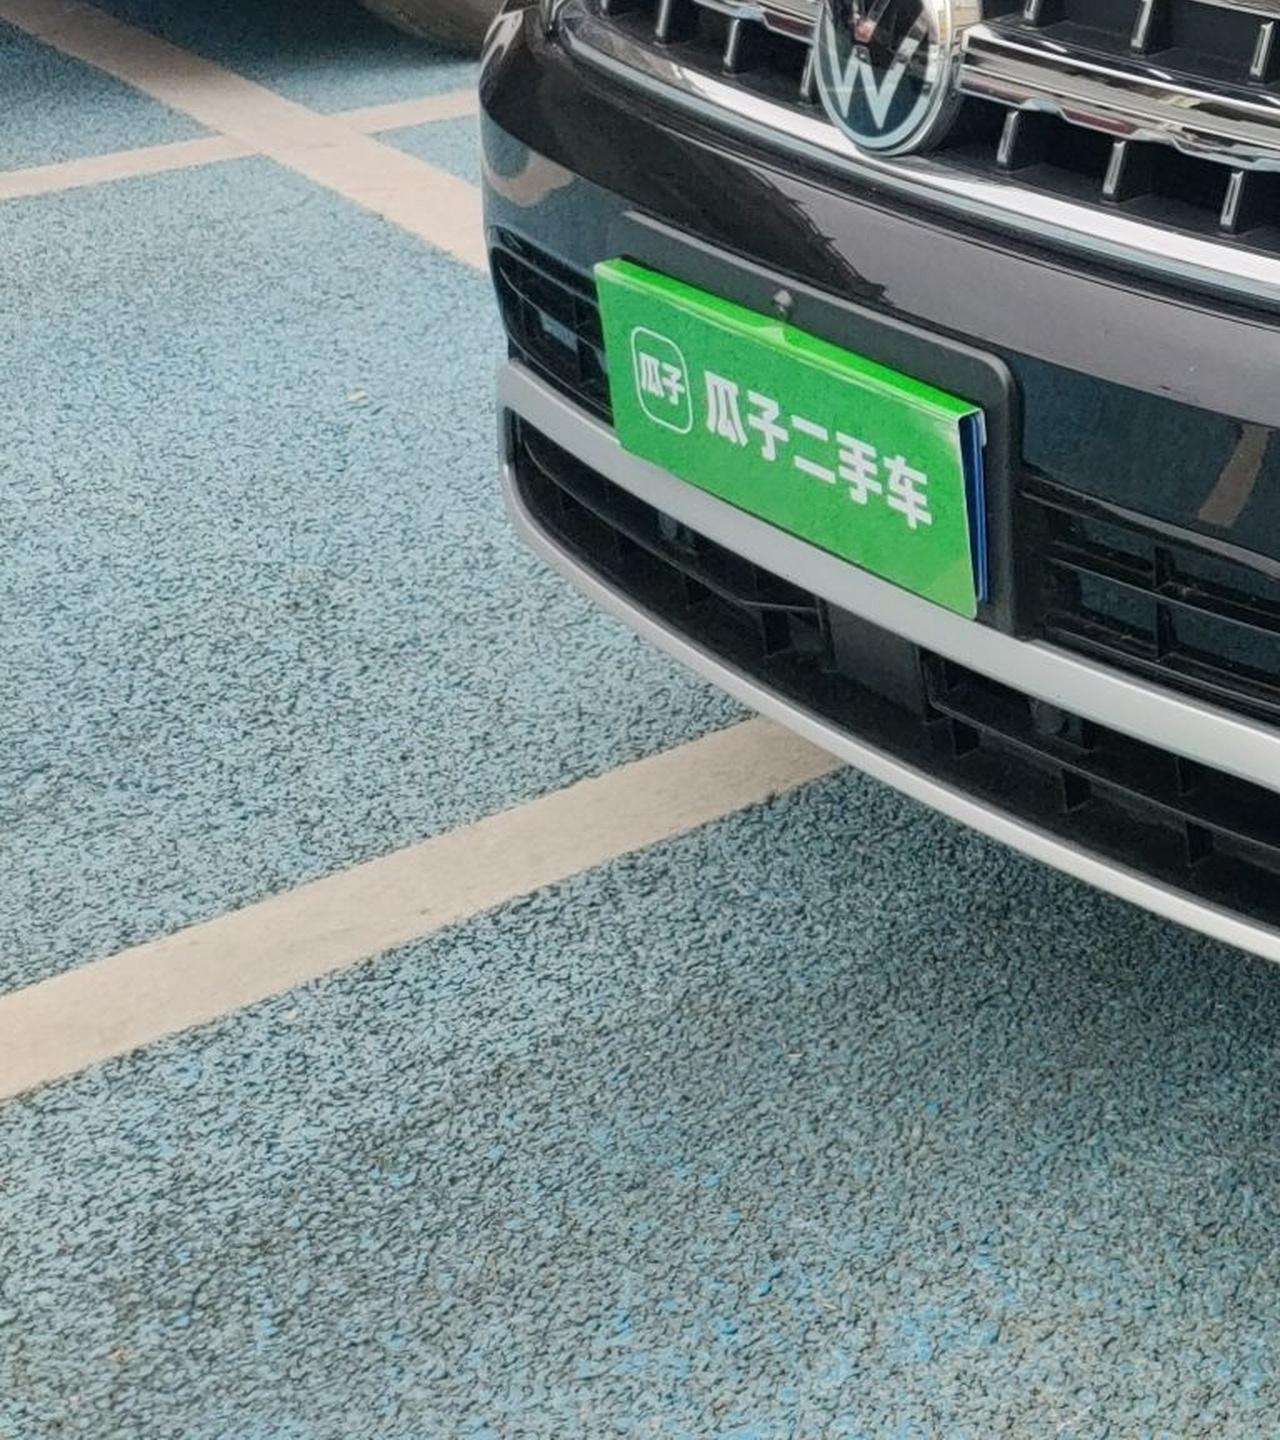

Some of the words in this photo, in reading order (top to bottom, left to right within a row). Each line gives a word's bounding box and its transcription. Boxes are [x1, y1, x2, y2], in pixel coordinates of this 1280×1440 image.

[638, 351, 686, 406] 瓜子
[704, 369, 933, 530] 瓜子二手车
